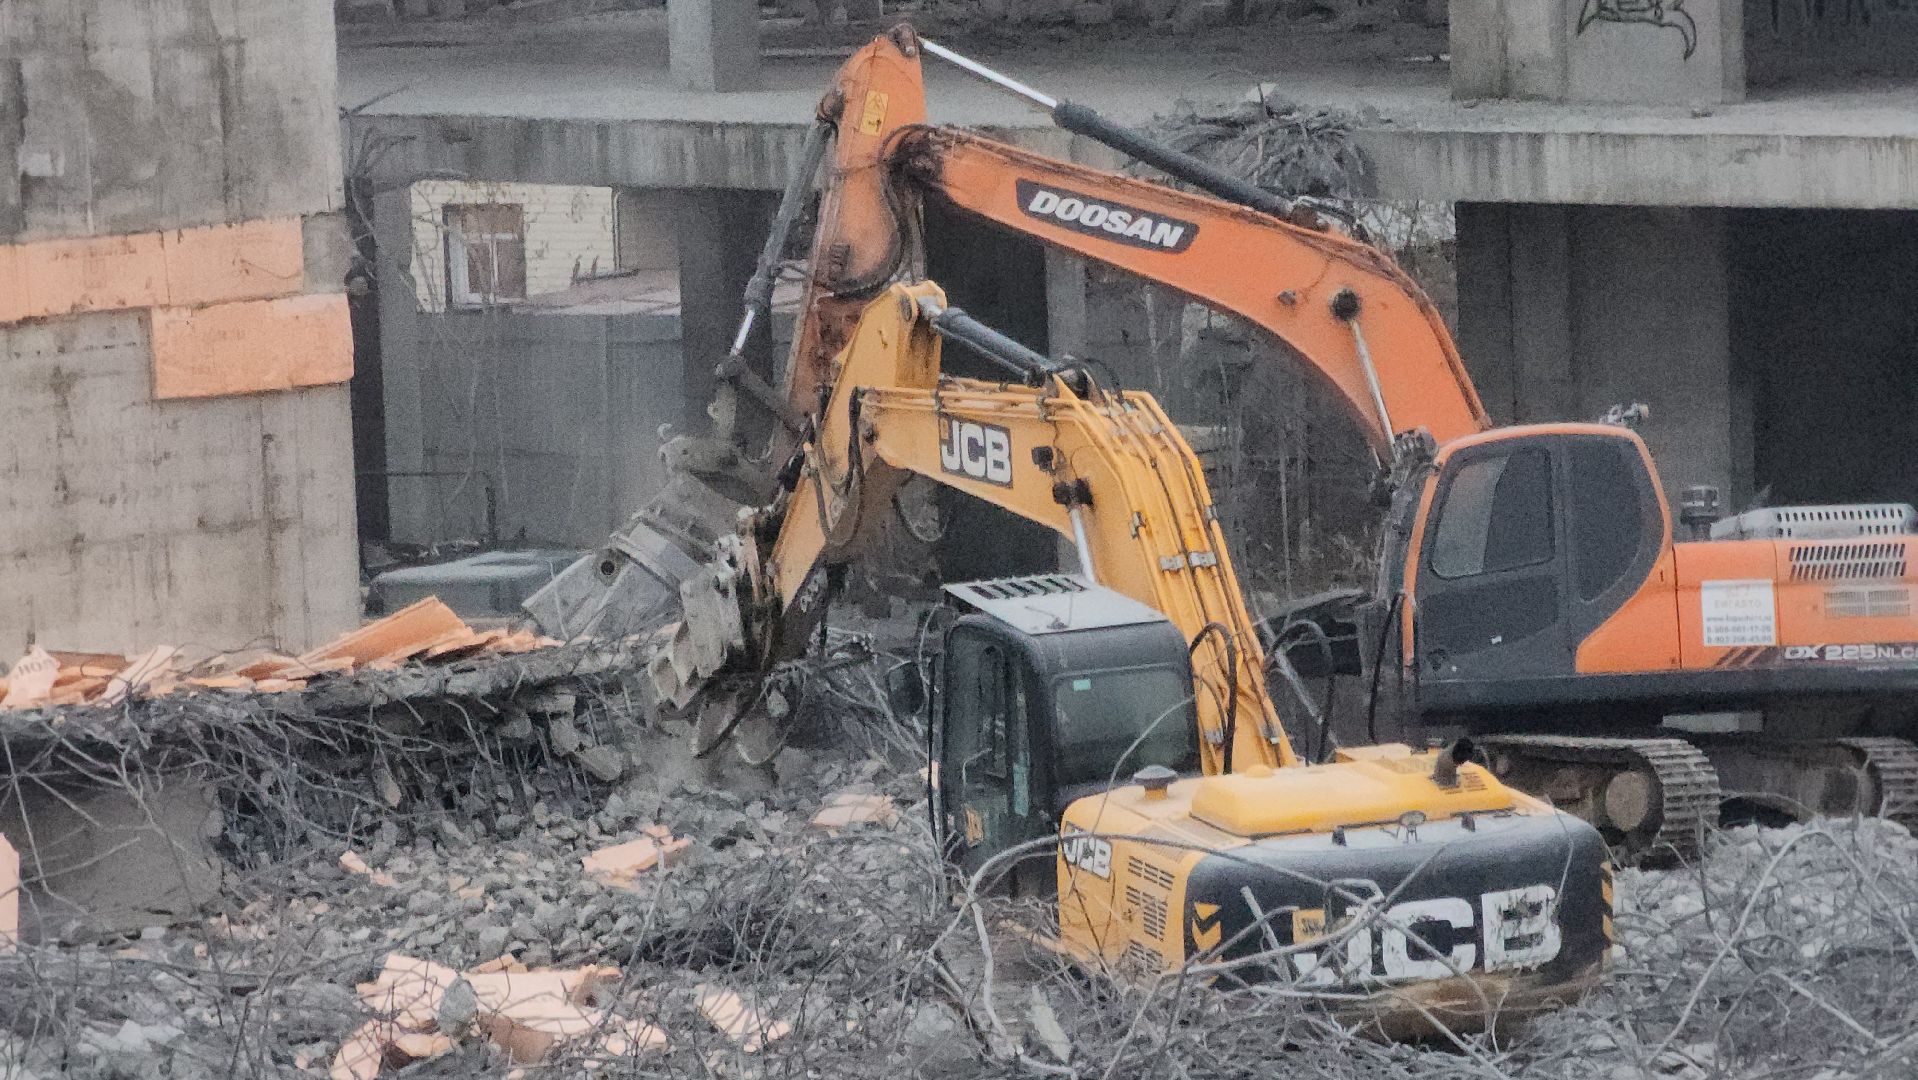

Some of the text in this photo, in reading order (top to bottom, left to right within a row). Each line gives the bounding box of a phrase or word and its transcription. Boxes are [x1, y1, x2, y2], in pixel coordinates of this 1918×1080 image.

[1028, 190, 1184, 248] DOOSAN
[941, 419, 1011, 483] JCB
[1064, 828, 1112, 880] JCB
[1293, 884, 1562, 984] JCB
